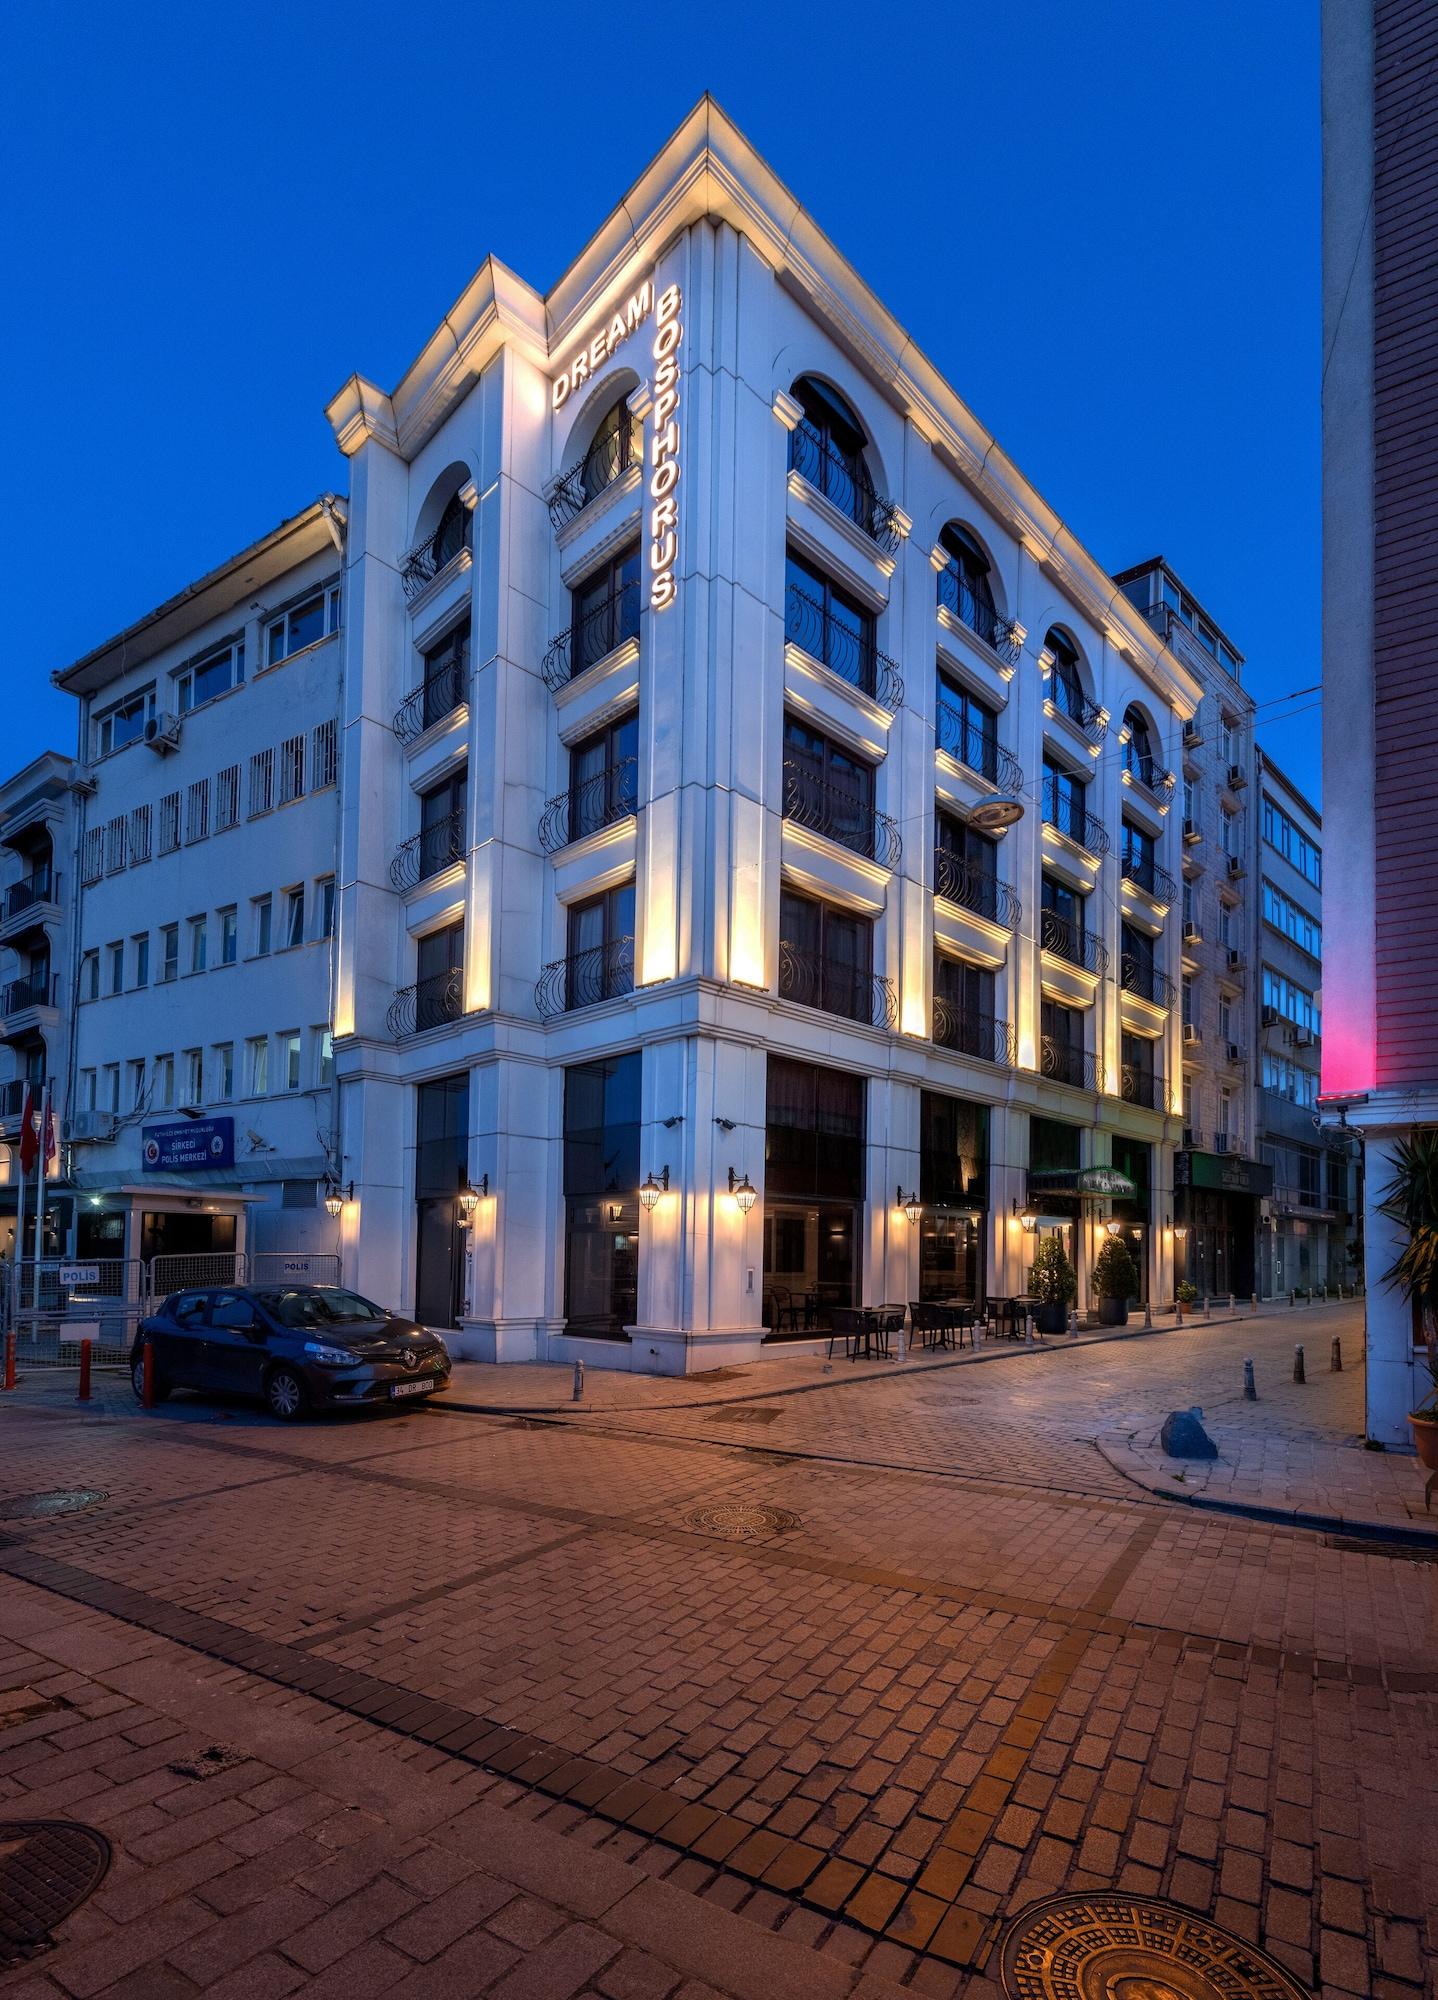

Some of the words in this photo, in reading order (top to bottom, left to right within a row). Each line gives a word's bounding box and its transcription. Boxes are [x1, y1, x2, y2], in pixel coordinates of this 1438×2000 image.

[552, 281, 654, 410] DREAM
[650, 284, 682, 609] BOSPHORUS
[171, 1139, 195, 1150] SİRKECİ
[161, 1154, 179, 1164] POLİS
[180, 1149, 207, 1161] MERKEZİ
[63, 1270, 96, 1281] POLİS
[396, 1386, 403, 1394] 34
